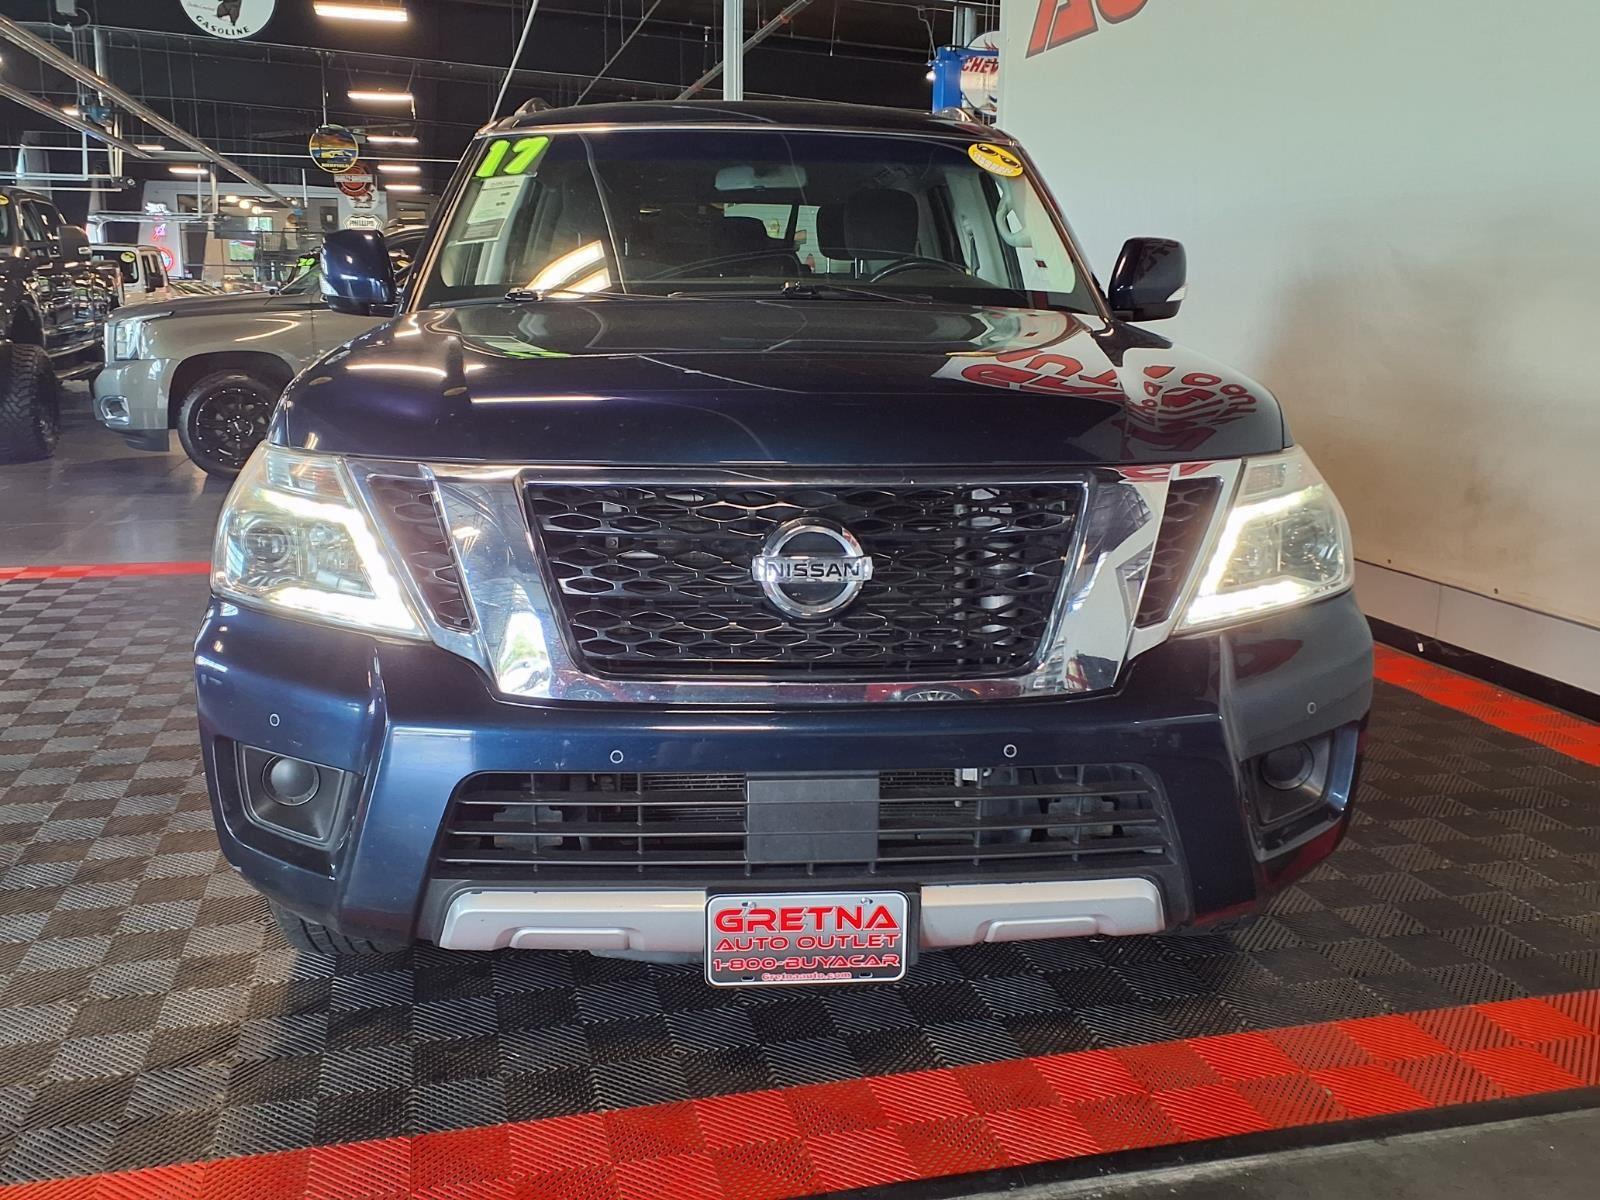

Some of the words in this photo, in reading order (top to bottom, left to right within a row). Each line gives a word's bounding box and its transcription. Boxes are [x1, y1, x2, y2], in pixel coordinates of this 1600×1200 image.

[196, 15, 250, 36] GASOLINE
[475, 136, 549, 177] 17
[766, 561, 860, 578] NISSAN
[714, 905, 900, 934] GRETNA
[714, 936, 789, 952] AUTO
[796, 934, 901, 950] OUTLET
[713, 954, 900, 972] 1-800-BUYACAR
